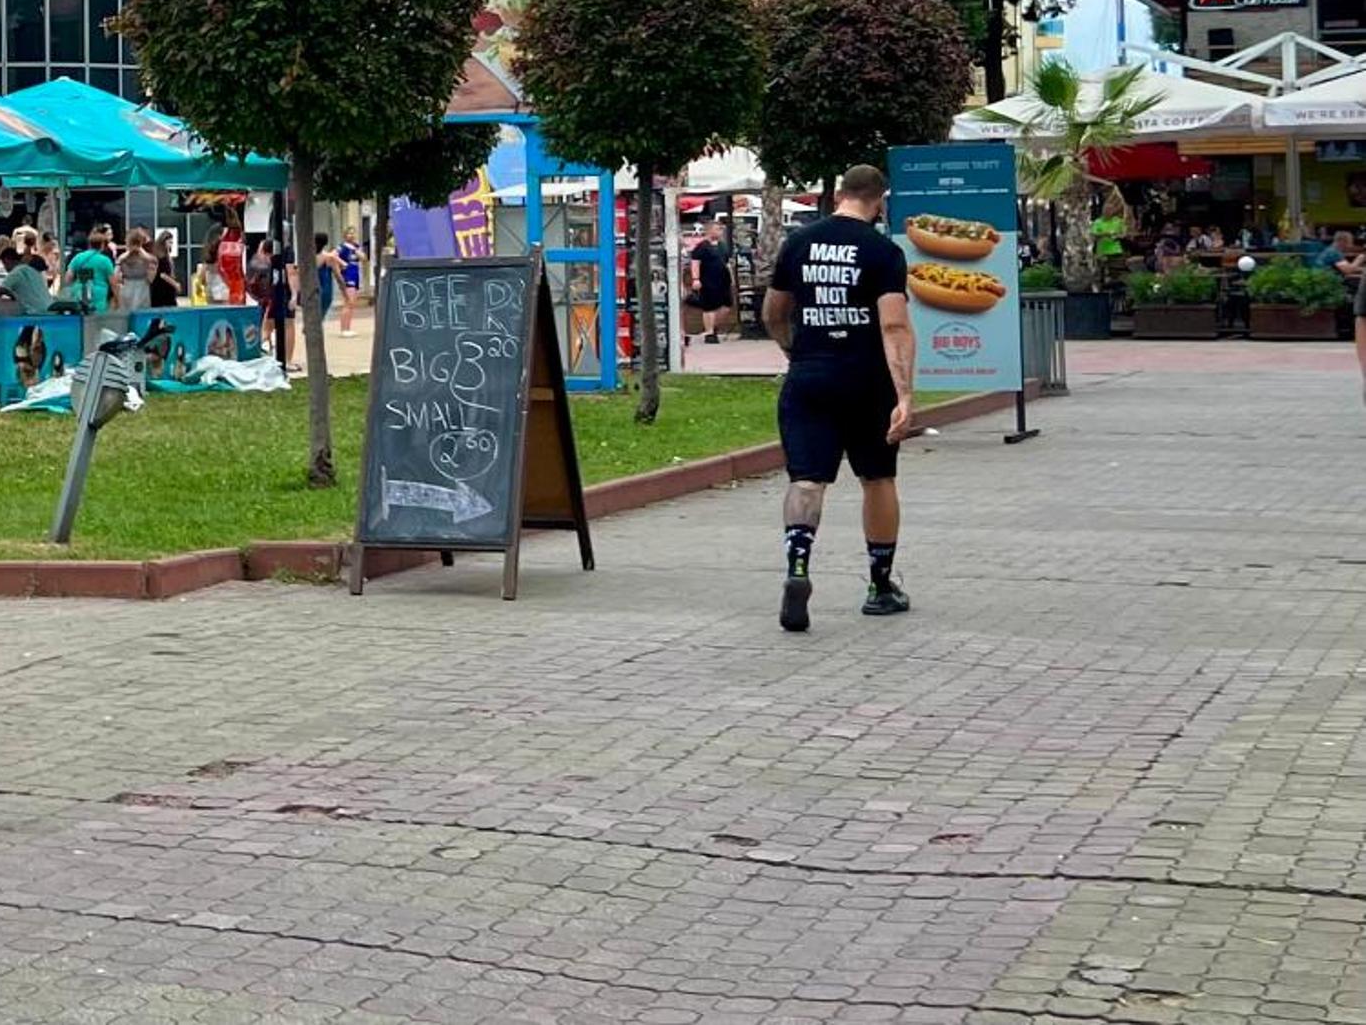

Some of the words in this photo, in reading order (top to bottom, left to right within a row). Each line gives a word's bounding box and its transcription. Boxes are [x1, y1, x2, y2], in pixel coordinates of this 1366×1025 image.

[810, 242, 858, 264] MAKE
[802, 264, 861, 286] MONEY
[816, 285, 847, 305] NOT
[802, 306, 870, 326] FRIENDS
[389, 347, 451, 383] BIG
[385, 399, 477, 431] SMALL
